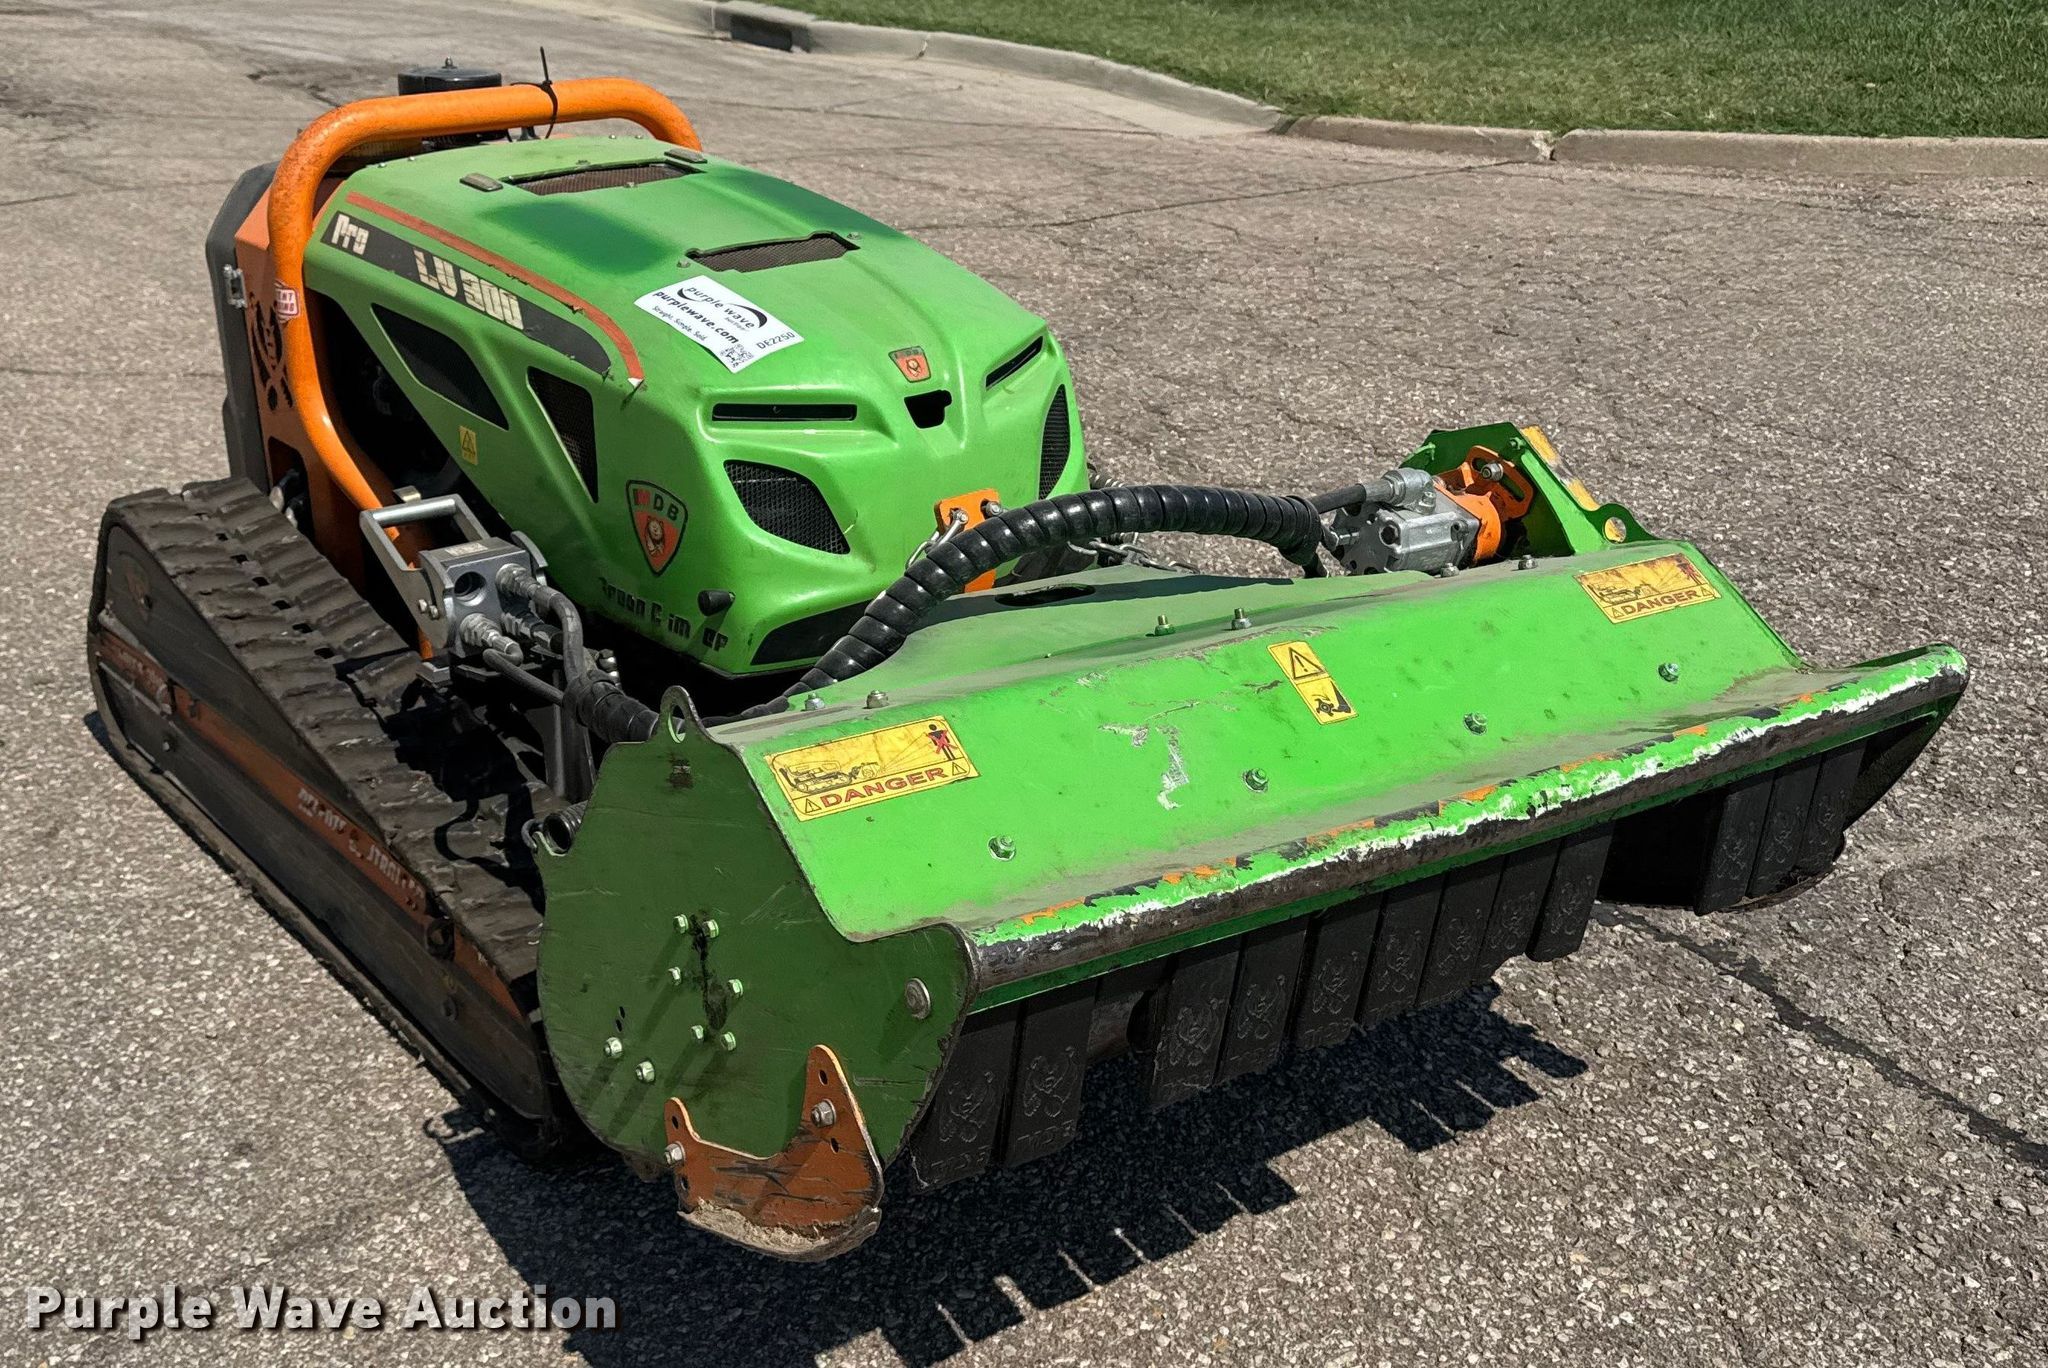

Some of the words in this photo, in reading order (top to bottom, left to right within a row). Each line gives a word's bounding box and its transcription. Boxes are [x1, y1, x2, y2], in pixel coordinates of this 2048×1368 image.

[331, 214, 369, 255] Pro
[459, 269, 524, 330] 300
[653, 290, 739, 344] purplewave.com
[686, 286, 724, 309] purple
[724, 308, 755, 329] wave
[1621, 590, 1698, 615] DANGER
[820, 767, 948, 808] DANGER
